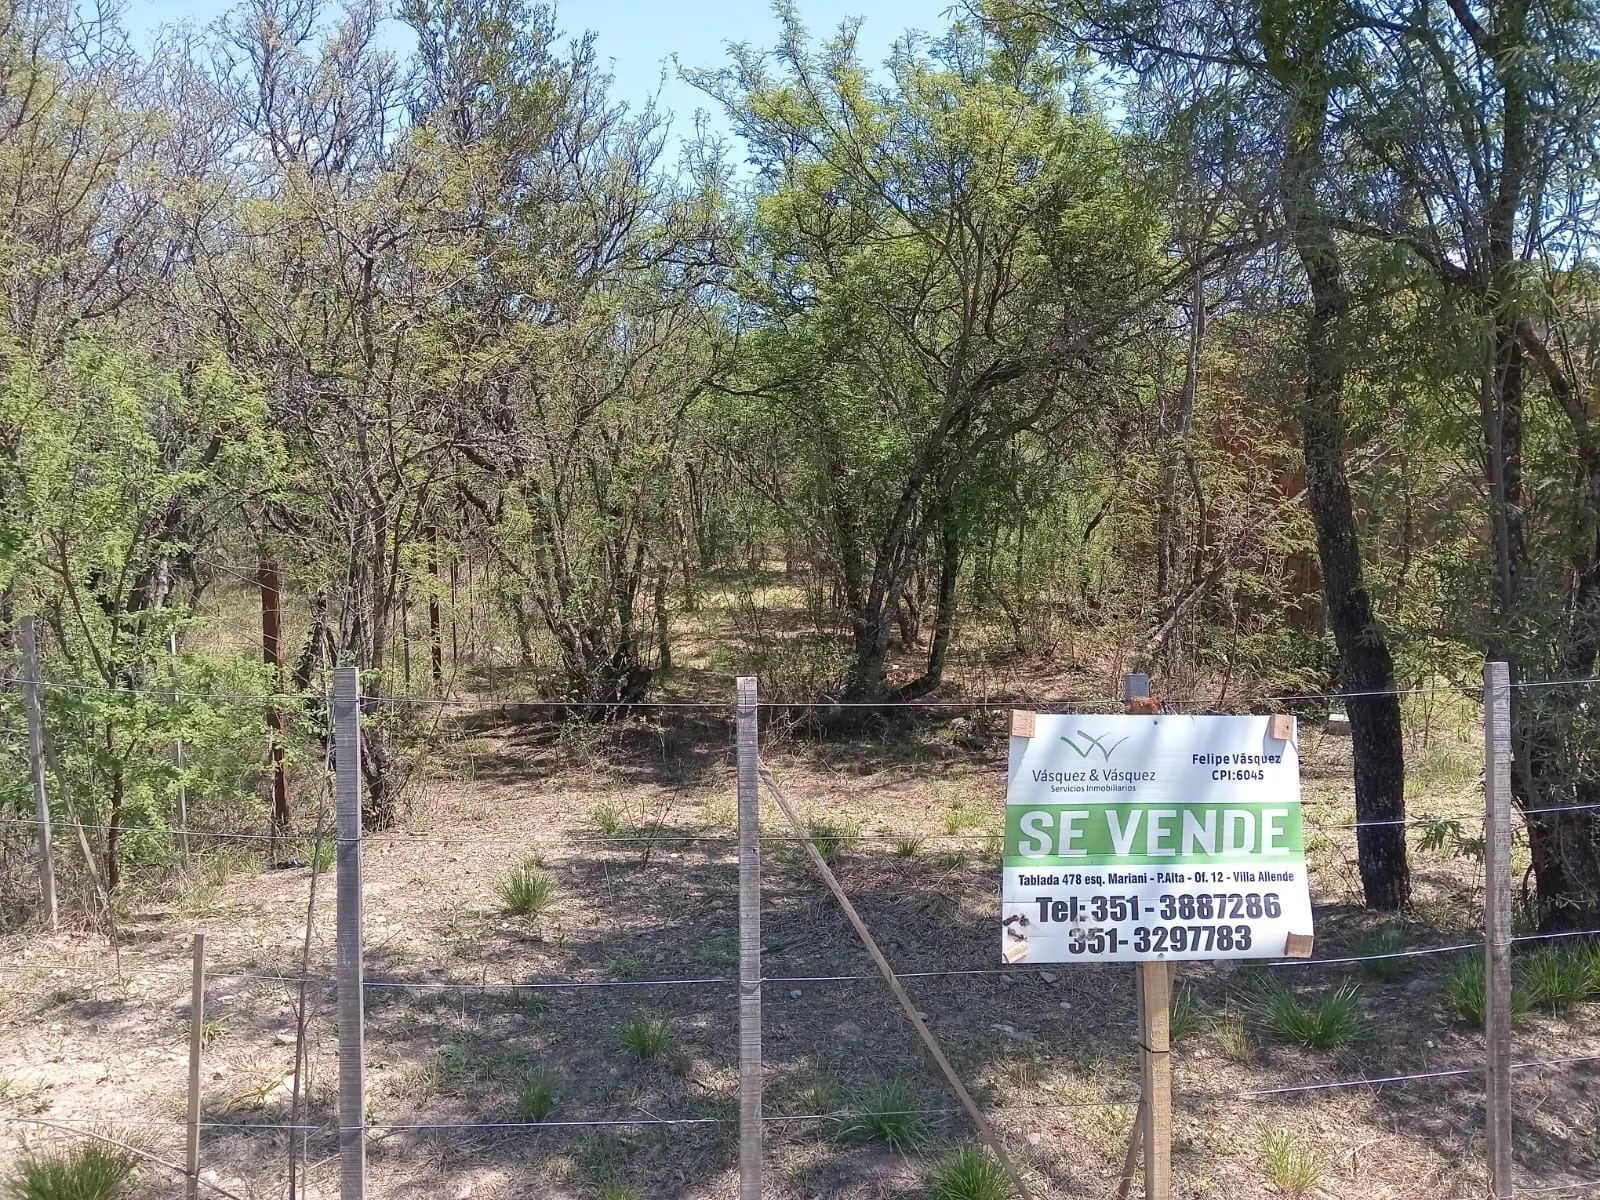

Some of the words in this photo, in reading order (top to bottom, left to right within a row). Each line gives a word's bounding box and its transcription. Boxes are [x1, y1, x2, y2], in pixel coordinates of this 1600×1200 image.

[1192, 753, 1230, 766] Felipe
[1232, 753, 1281, 765] Vásquez
[1032, 769, 1086, 783] Vásquez
[1089, 769, 1099, 781] &
[1103, 769, 1156, 783] Vásquez
[1211, 770, 1264, 781] CPI:6045
[1086, 784, 1137, 792] Inmobiliarios
[1018, 810, 1090, 859] SE
[1105, 808, 1290, 858] VENDE
[1018, 874, 1060, 886] Tablada
[1062, 874, 1082, 885] 478
[1084, 875, 1106, 887] esq.
[1108, 873, 1147, 884] Mariani
[1157, 872, 1185, 884] P.Alta
[1194, 871, 1209, 883] Of.
[1211, 871, 1224, 883] 12
[1233, 871, 1255, 882] Villa
[1258, 871, 1294, 882] Allende
[1160, 893, 1281, 920] 3887286
[1134, 925, 1252, 953] 3297783
